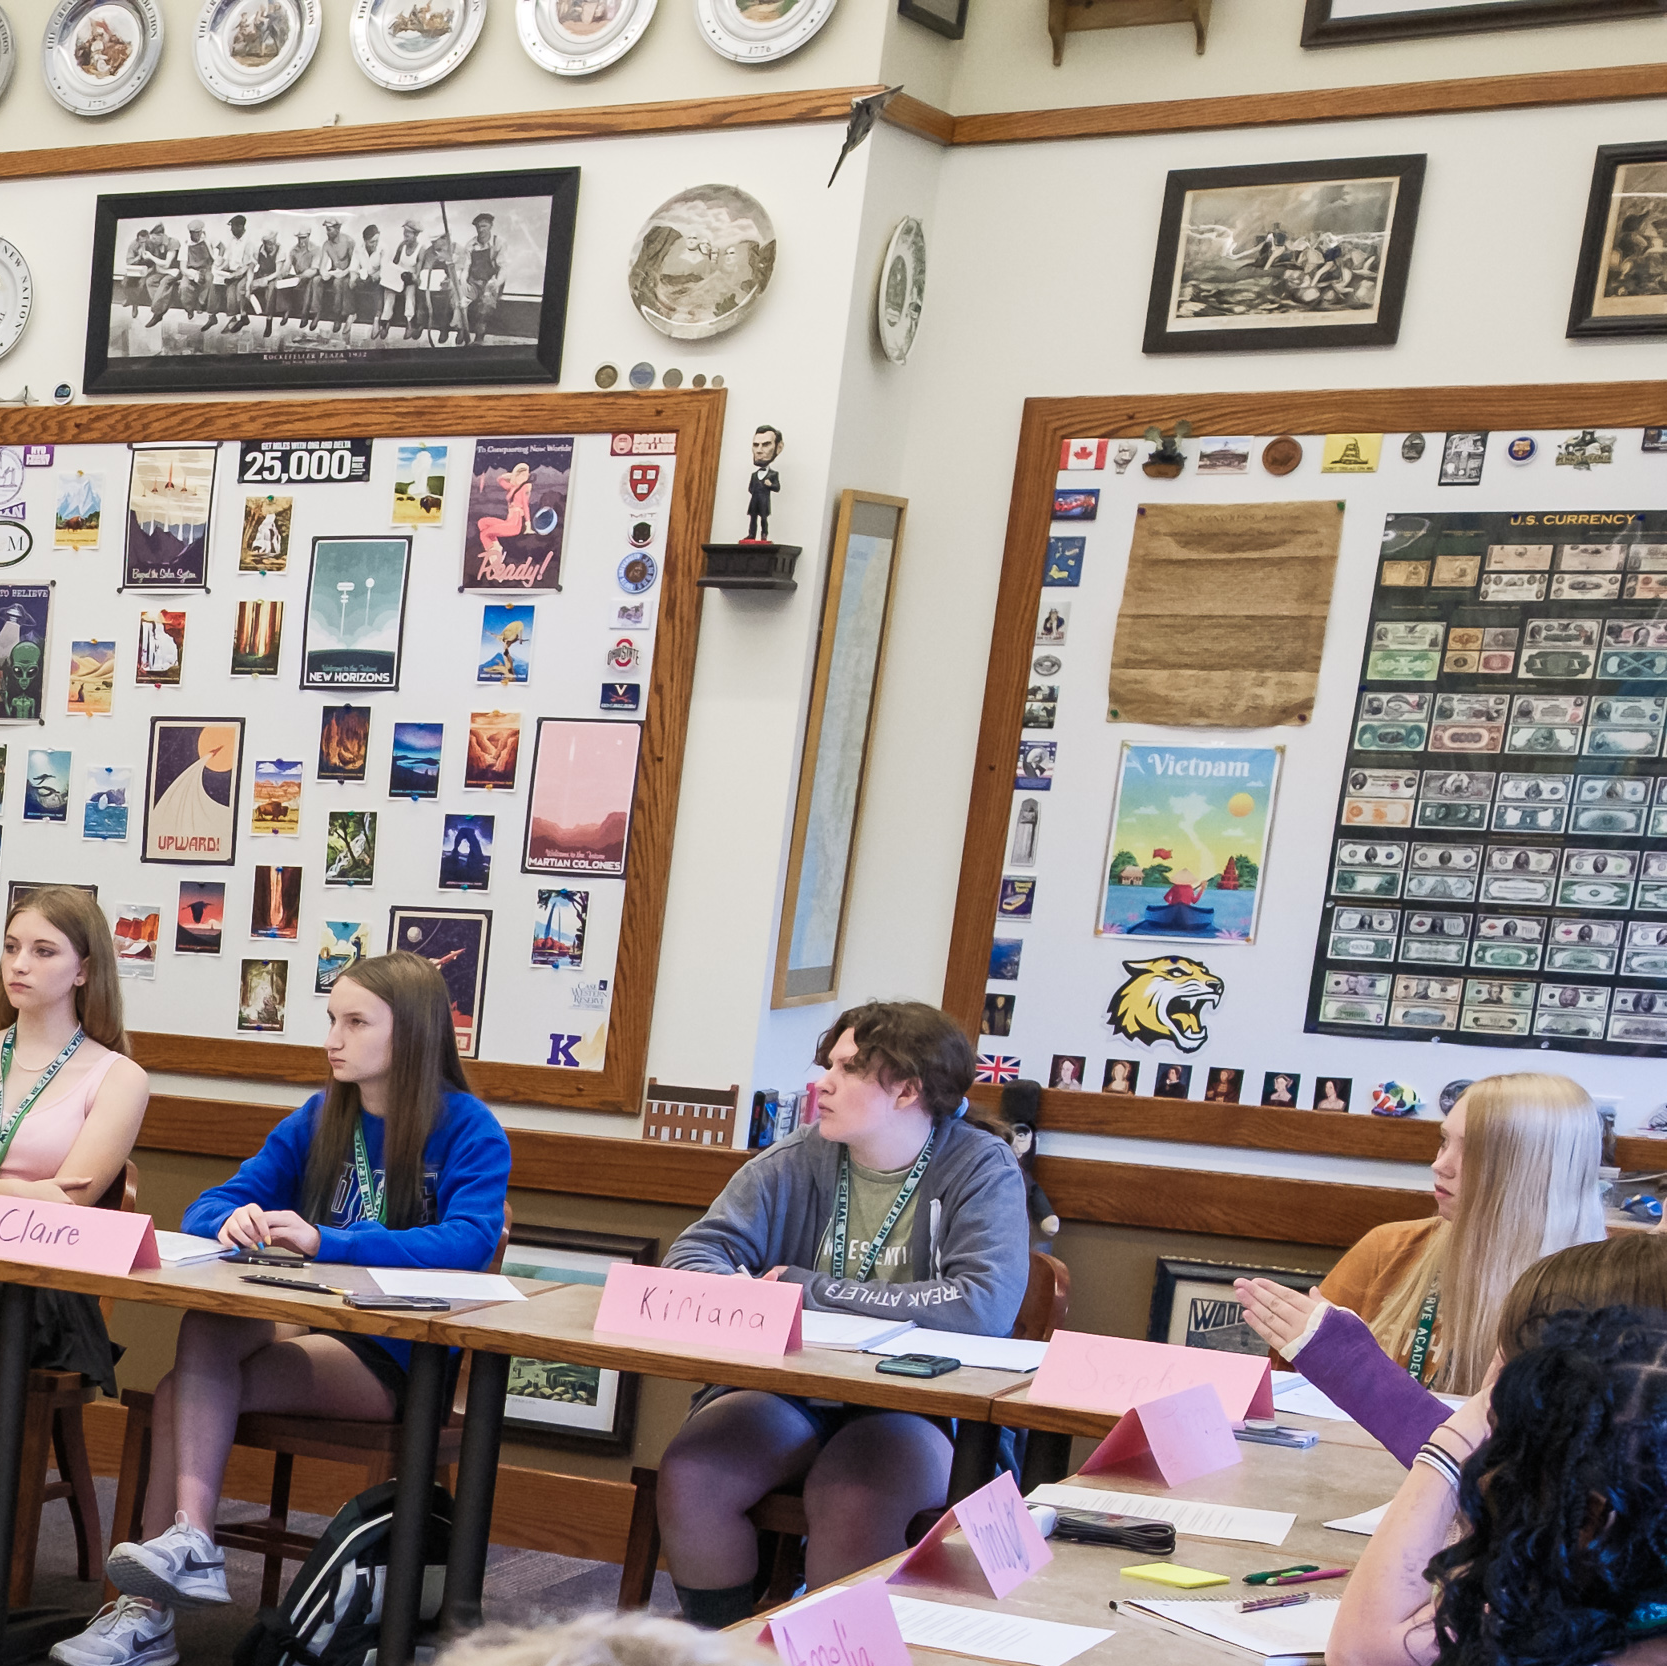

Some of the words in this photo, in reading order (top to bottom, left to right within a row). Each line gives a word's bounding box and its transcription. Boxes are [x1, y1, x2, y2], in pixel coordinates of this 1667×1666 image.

[2, 245, 23, 268] NEW
[263, 353, 316, 361] ROCKEFELLER
[319, 352, 345, 360] PLAZA
[243, 450, 352, 484] 25,000
[1510, 514, 1538, 526] U.S.
[1543, 513, 1636, 526] CURRENCY
[12, 589, 48, 597] BELIEVE
[309, 672, 332, 682] NEW
[334, 672, 390, 683] HORIZONS
[1147, 753, 1250, 778] Vietnam
[158, 835, 219, 852] UPWARD!
[528, 857, 570, 867] MARTIAN
[572, 859, 621, 870] COLONIES
[546, 1033, 582, 1068] K
[639, 1286, 766, 1331] Kiriana
[1071, 1347, 1194, 1403] Soph
